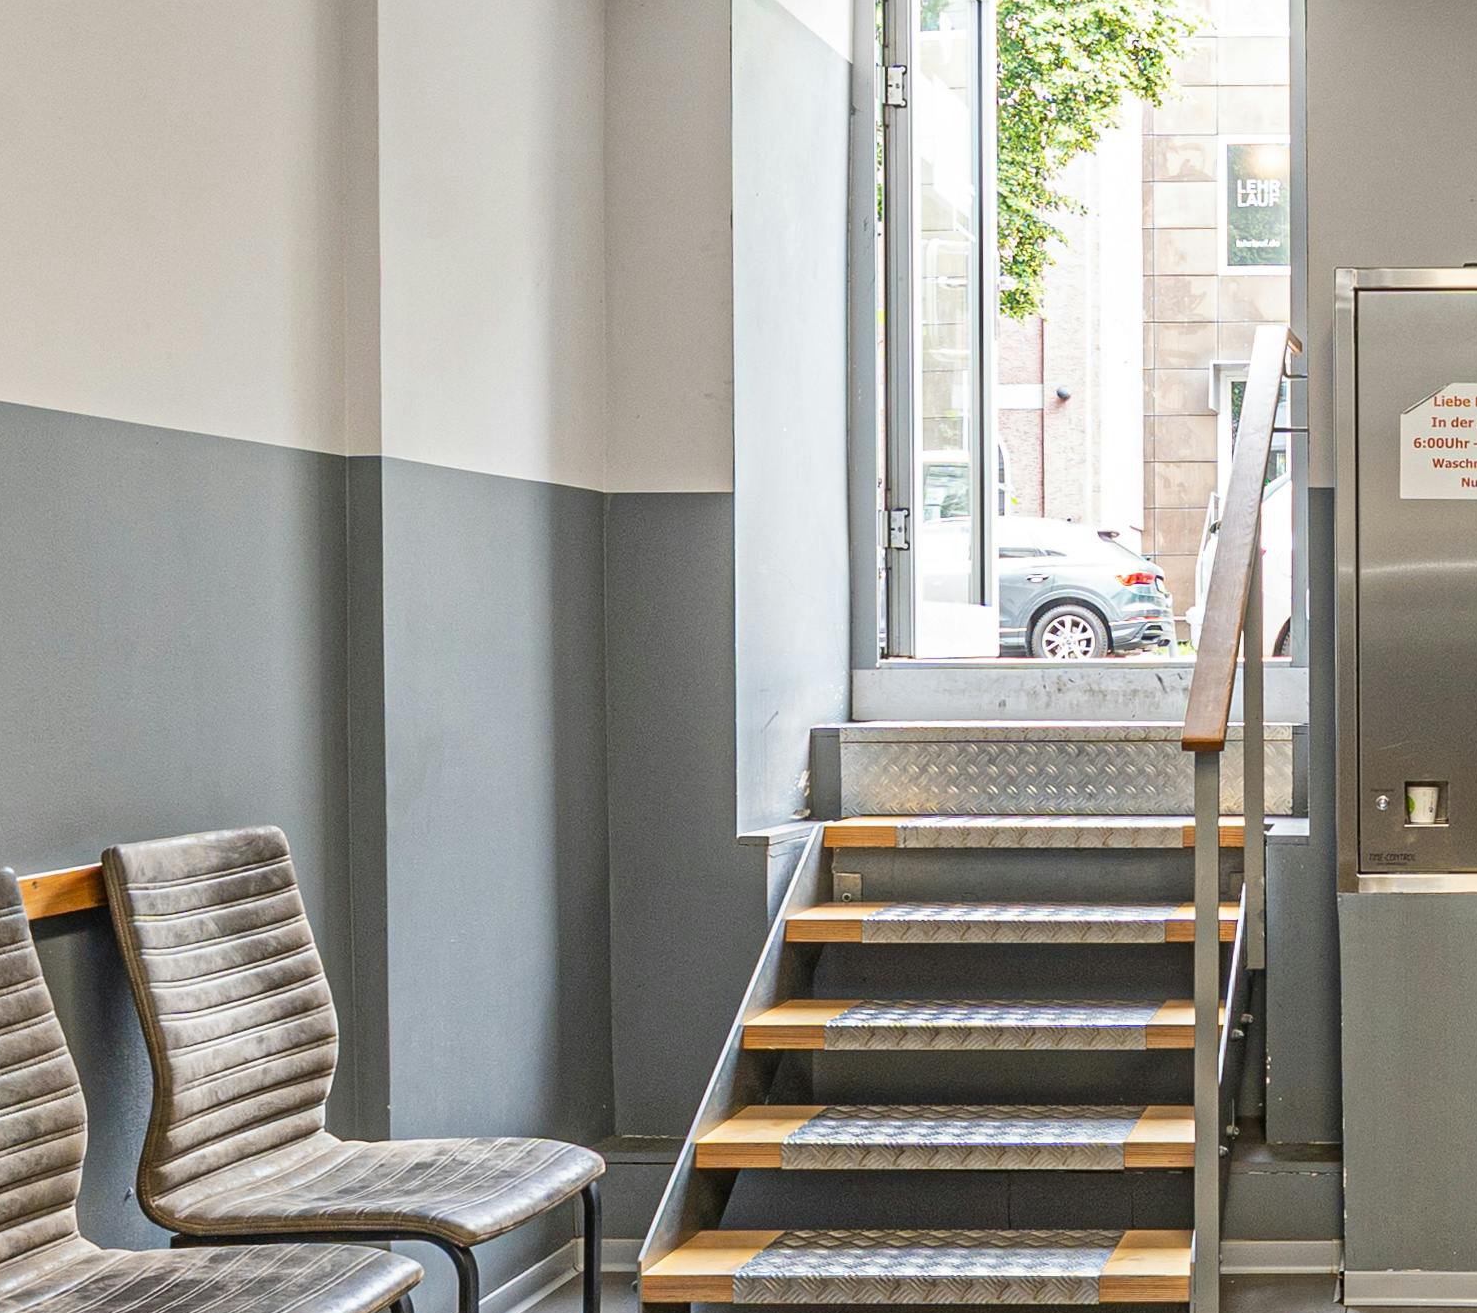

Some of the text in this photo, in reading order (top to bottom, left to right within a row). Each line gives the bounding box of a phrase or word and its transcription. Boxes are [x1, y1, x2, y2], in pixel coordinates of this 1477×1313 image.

[1237, 179, 1281, 193] LEHR
[1237, 192, 1279, 207] LAUF
[1433, 396, 1471, 408] Liebe
[1431, 417, 1446, 428] In
[1451, 417, 1474, 428] der
[1413, 437, 1470, 449] 6:00Uhr
